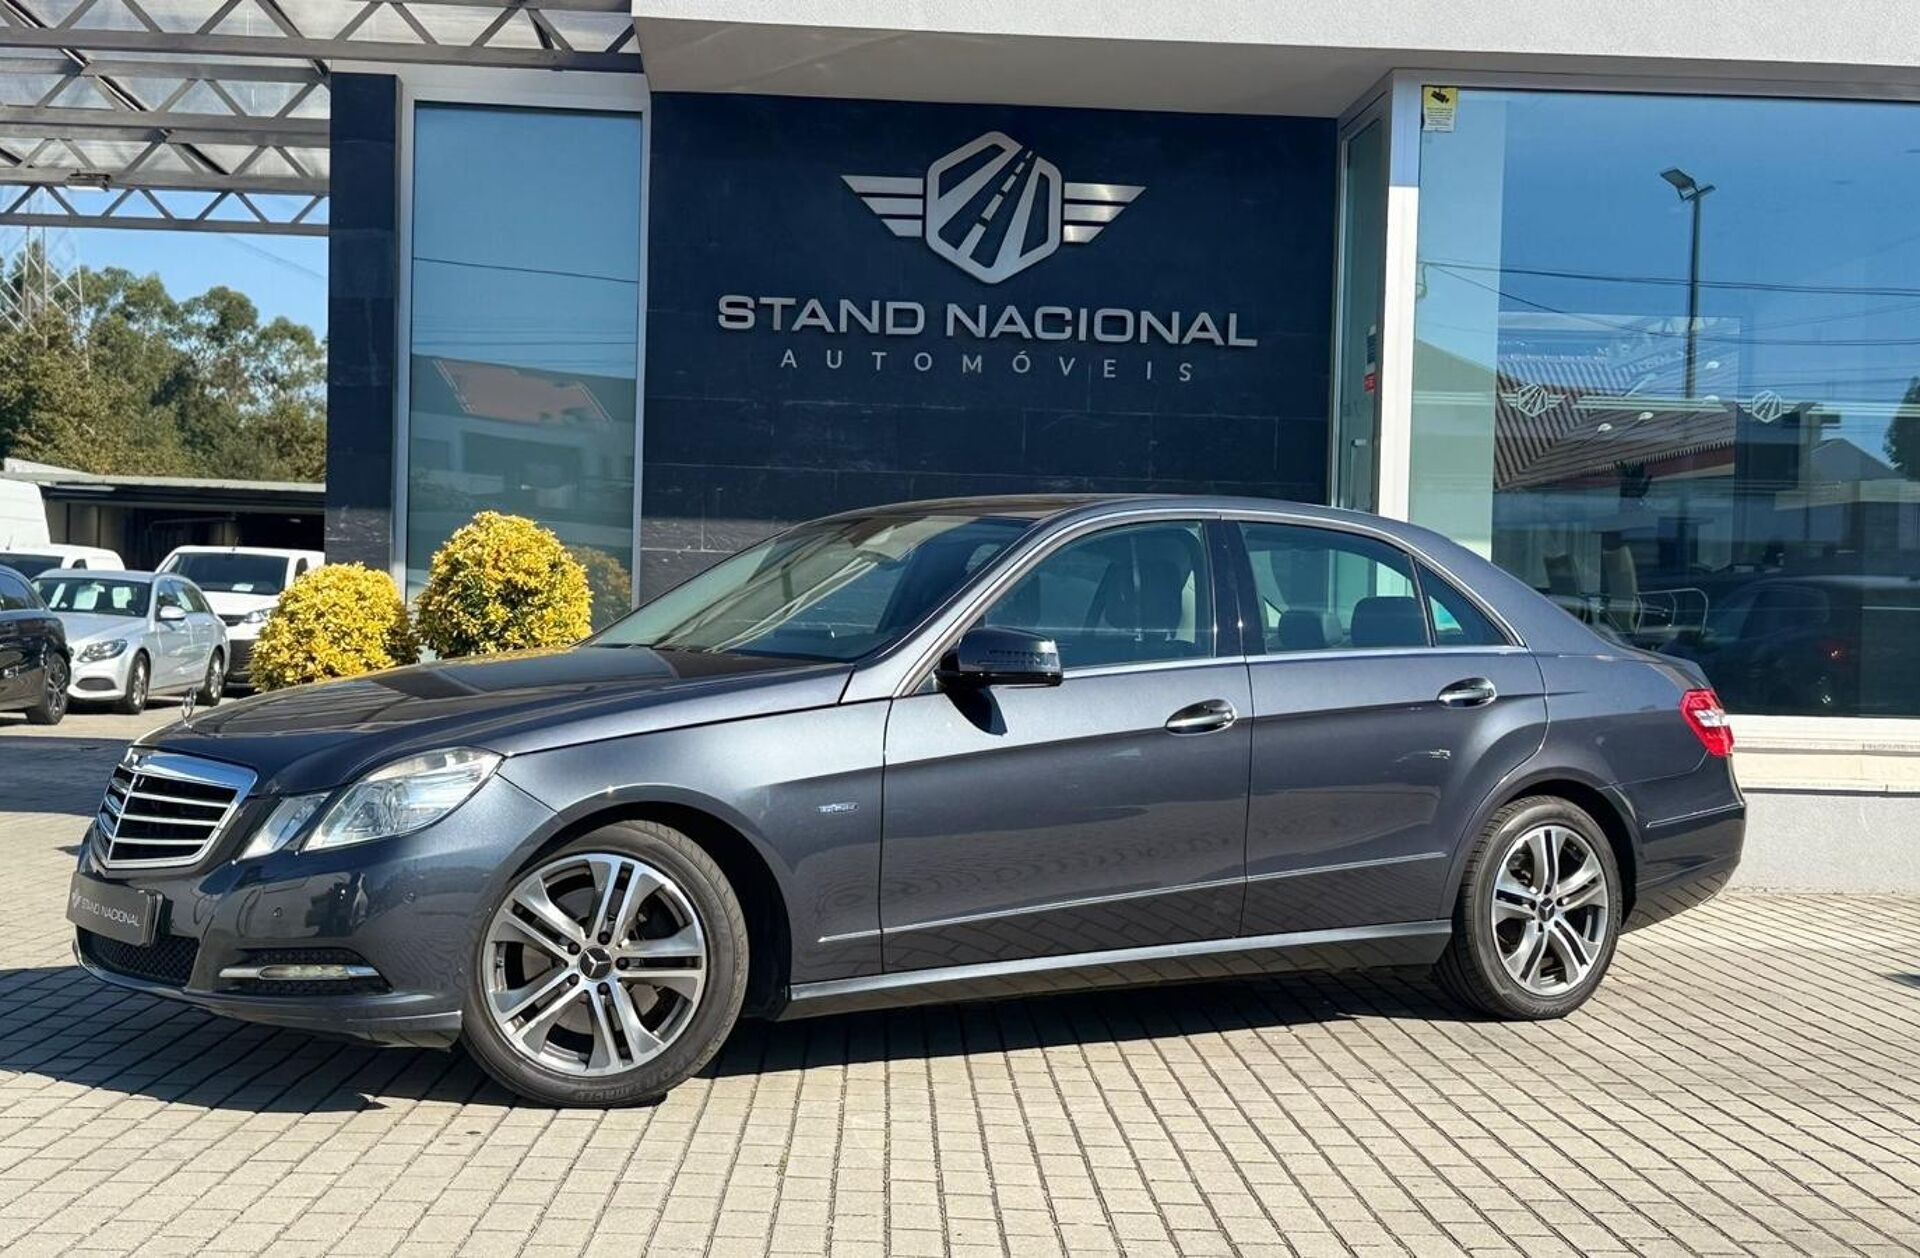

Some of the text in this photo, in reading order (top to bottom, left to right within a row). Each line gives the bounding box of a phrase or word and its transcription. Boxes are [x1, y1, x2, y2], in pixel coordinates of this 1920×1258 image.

[717, 294, 1258, 348] STAND NACIONAL
[780, 348, 1193, 382] AUTOMÓVEIS
